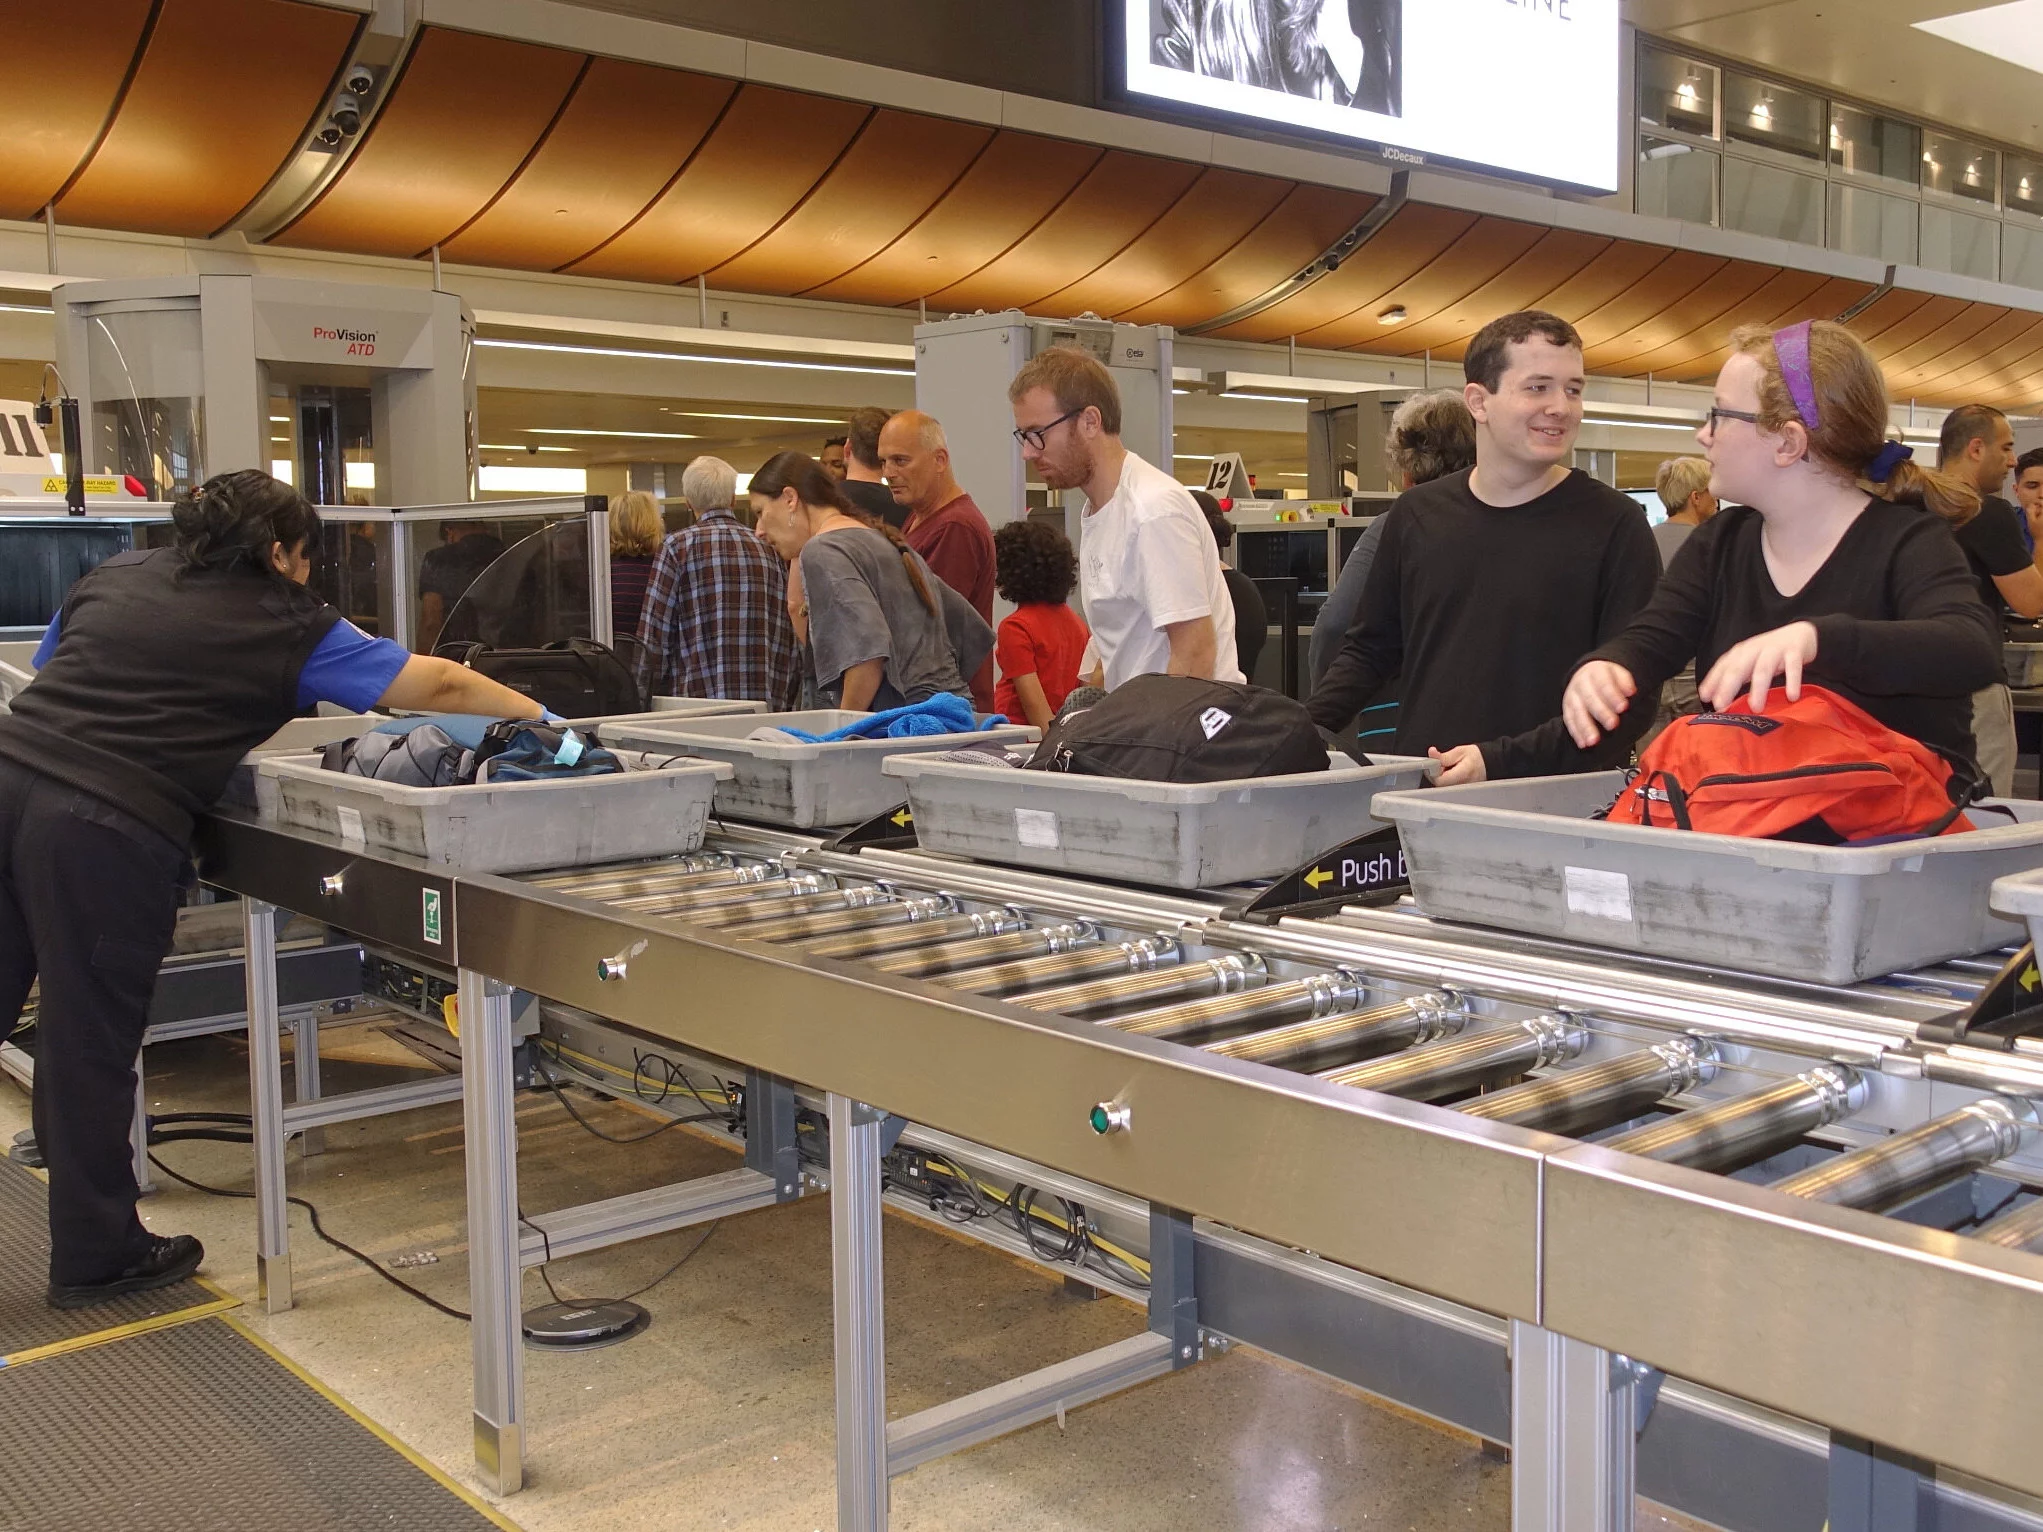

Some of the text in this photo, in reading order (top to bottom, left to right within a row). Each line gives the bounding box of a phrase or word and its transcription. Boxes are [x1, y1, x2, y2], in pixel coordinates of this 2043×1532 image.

[1382, 146, 1424, 166] JCDecaux
[313, 327, 376, 342] ProVision
[347, 343, 375, 356] ATD
[1206, 460, 1232, 491] 12
[1342, 852, 1391, 887] Push
